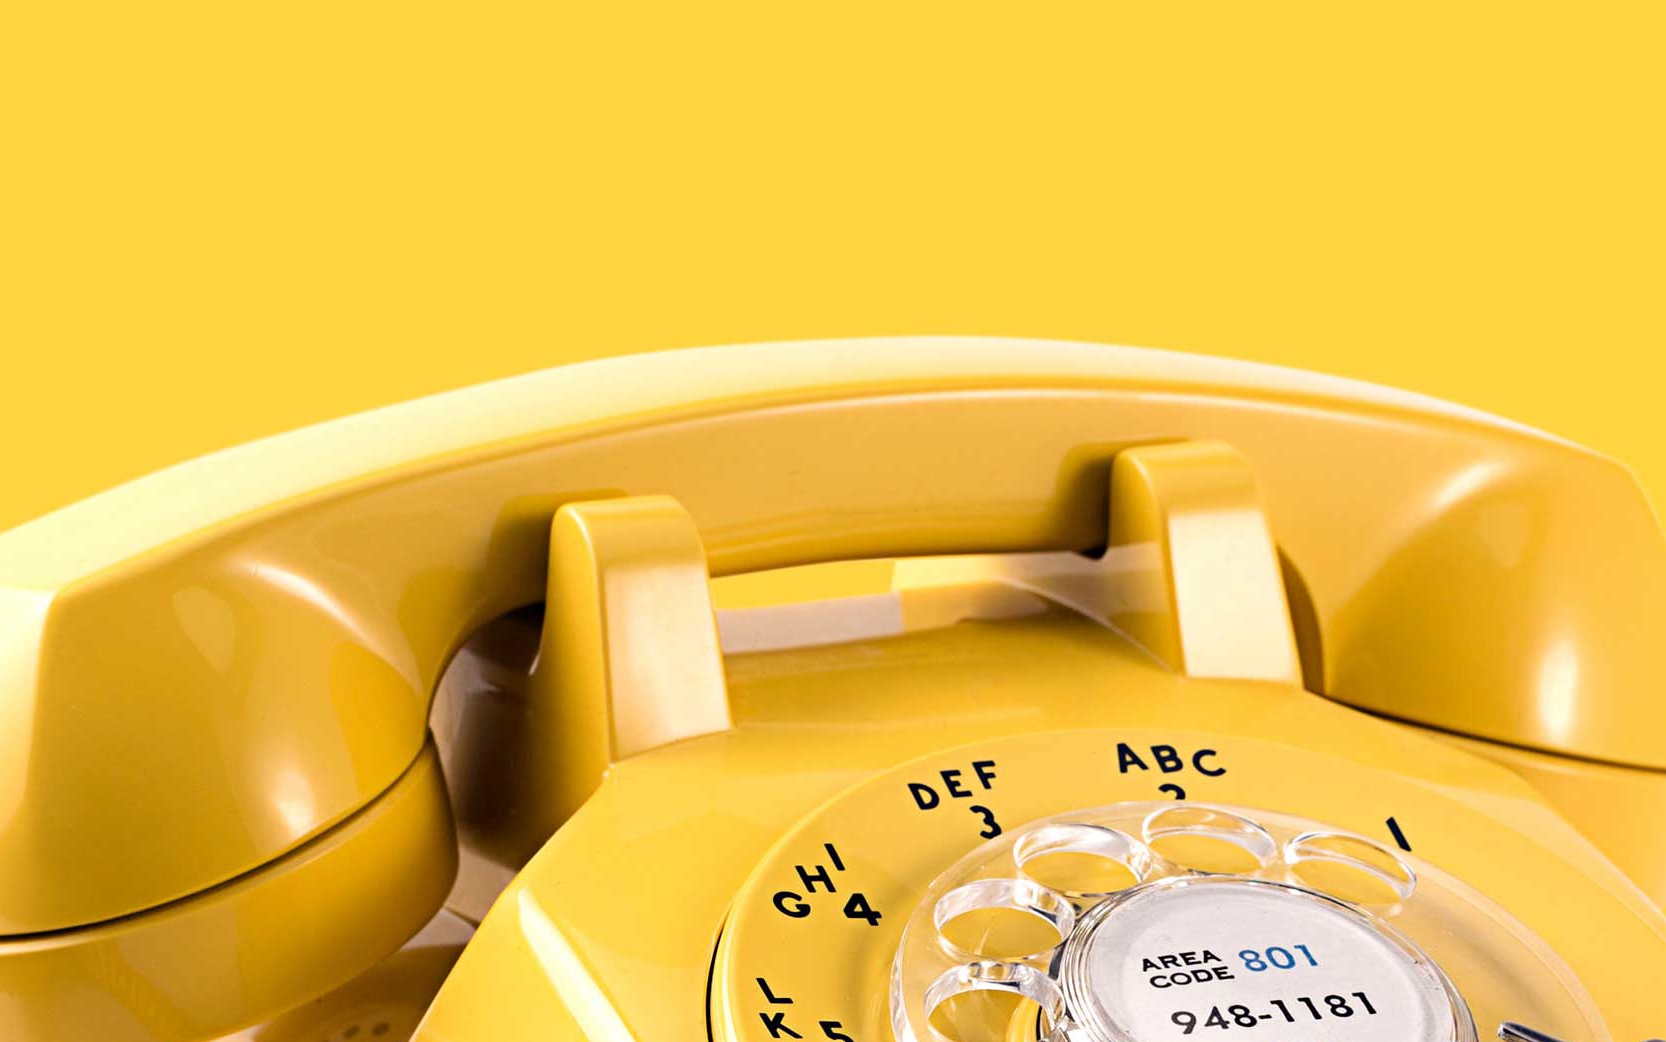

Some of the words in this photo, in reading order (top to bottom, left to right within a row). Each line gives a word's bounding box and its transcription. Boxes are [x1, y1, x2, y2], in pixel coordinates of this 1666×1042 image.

[1117, 743, 1226, 776] ABC
[908, 761, 995, 810] DEF
[970, 806, 1001, 839] 3
[773, 844, 846, 918] GHI
[844, 893, 882, 926] 4
[1142, 949, 1222, 973] AREA
[1238, 944, 1319, 972] 801
[1150, 966, 1234, 988] CODE
[1170, 991, 1378, 1035] 948-1181
